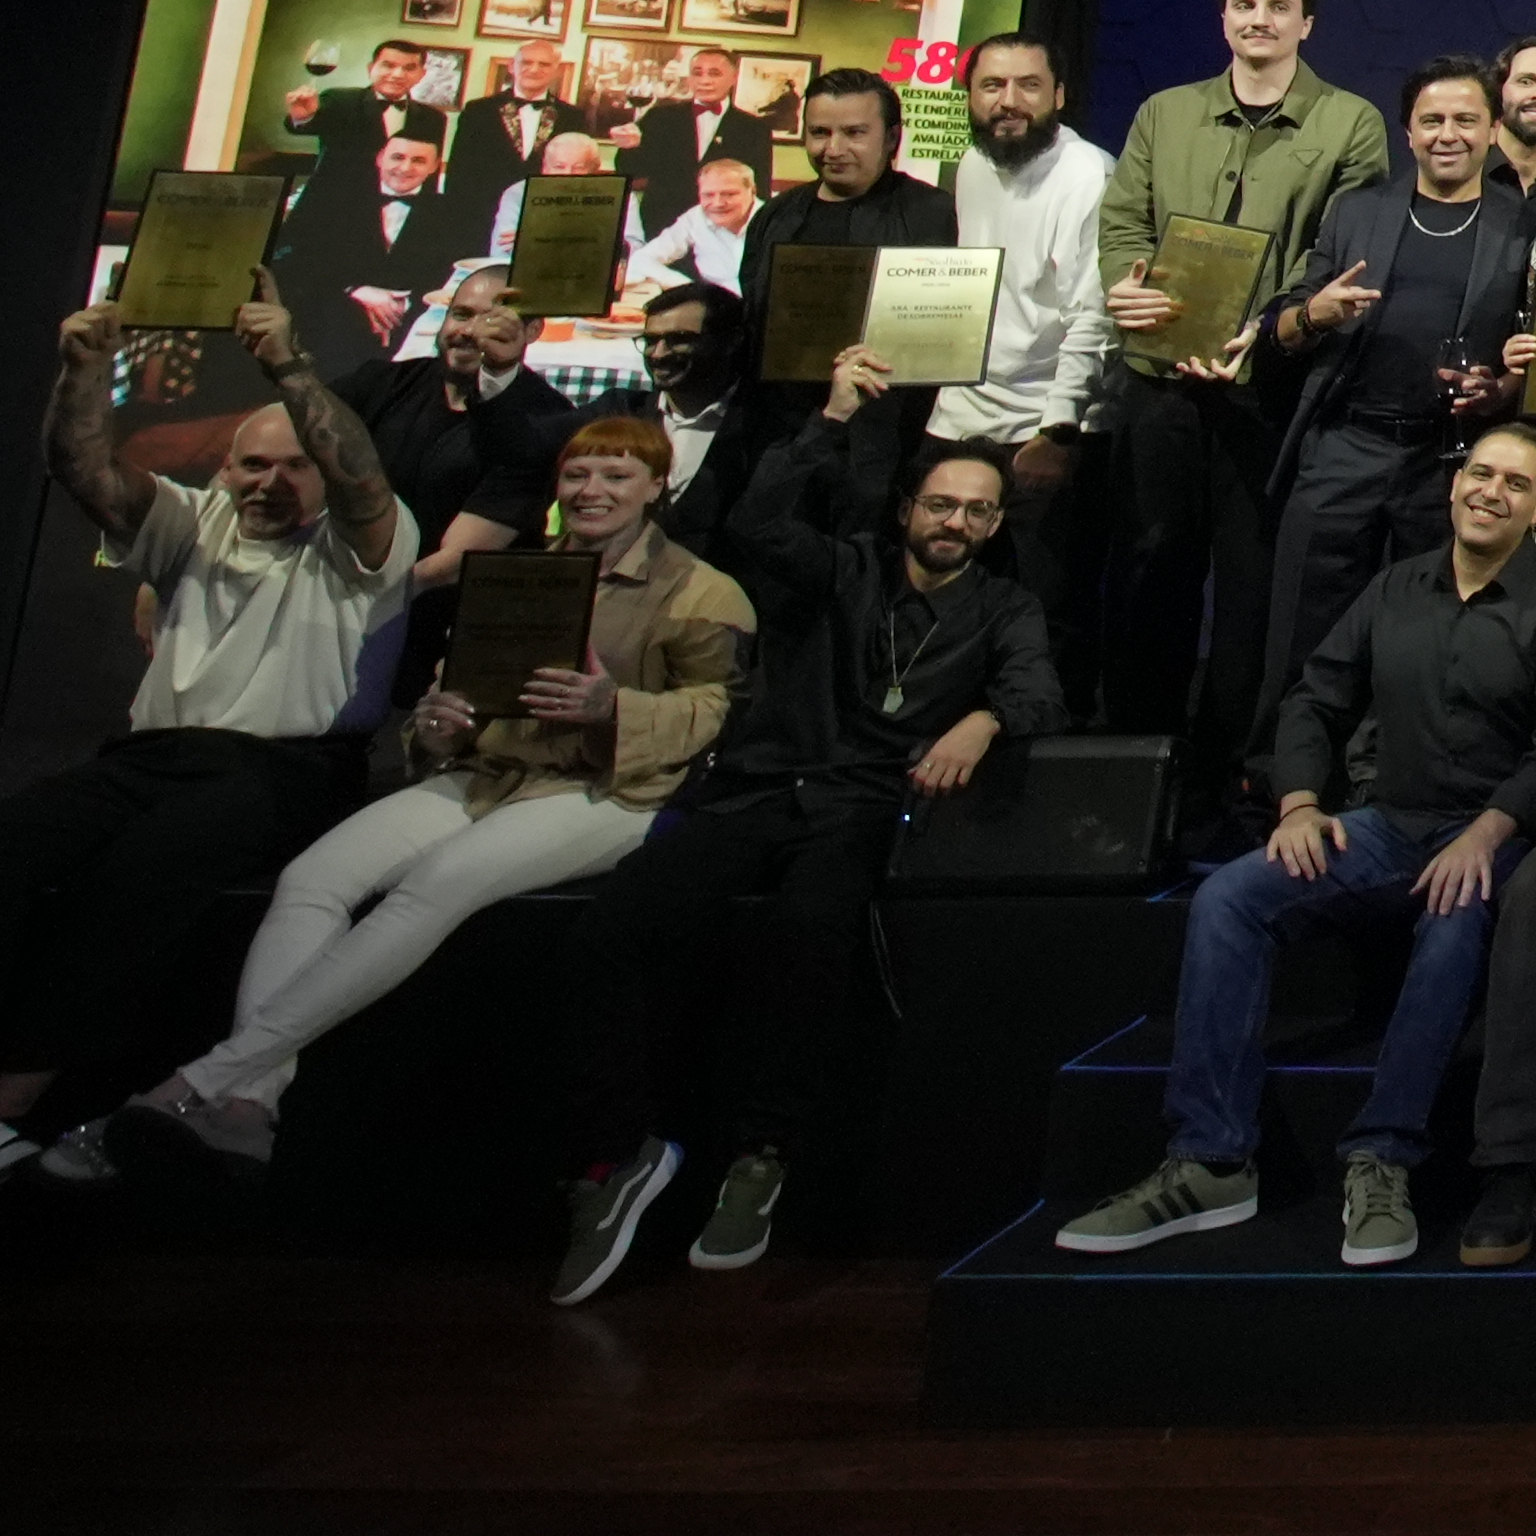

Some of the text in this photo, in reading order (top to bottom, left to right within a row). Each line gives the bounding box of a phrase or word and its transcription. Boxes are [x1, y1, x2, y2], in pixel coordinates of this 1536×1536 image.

[912, 133, 972, 145] AVALIADO
[887, 267, 936, 277] COMER
[948, 267, 988, 277] BEBER
